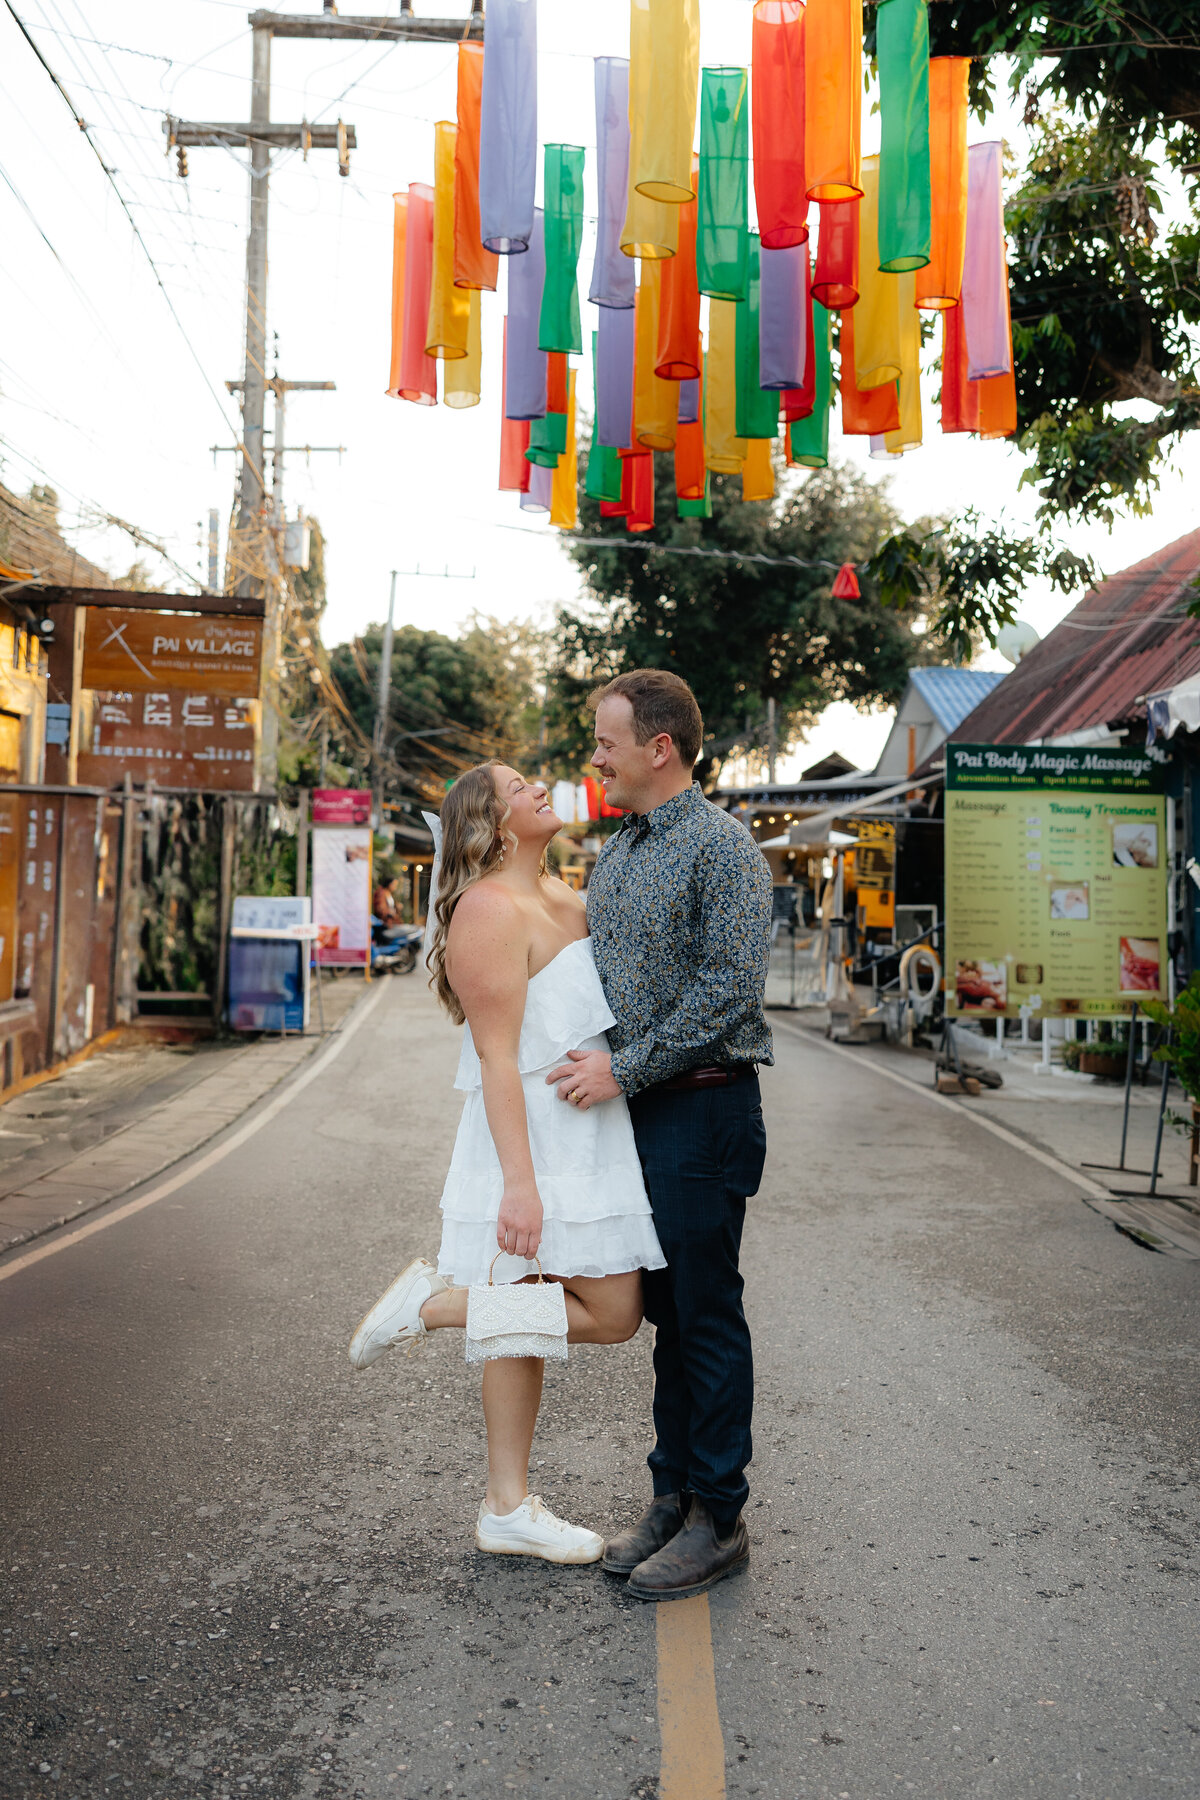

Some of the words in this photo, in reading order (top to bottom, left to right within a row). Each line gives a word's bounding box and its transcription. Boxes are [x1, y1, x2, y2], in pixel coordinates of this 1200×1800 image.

[152, 636, 180, 655] PAI
[185, 638, 254, 656] VILLAGE
[954, 751, 983, 768] Pai
[985, 751, 1027, 774] Body
[1029, 753, 1079, 775] Magic
[1081, 754, 1151, 777] Massage
[1043, 776, 1066, 785] Open
[952, 800, 1008, 815] Massage
[1049, 803, 1092, 818] Beauty
[1094, 803, 1157, 816] Treatment
